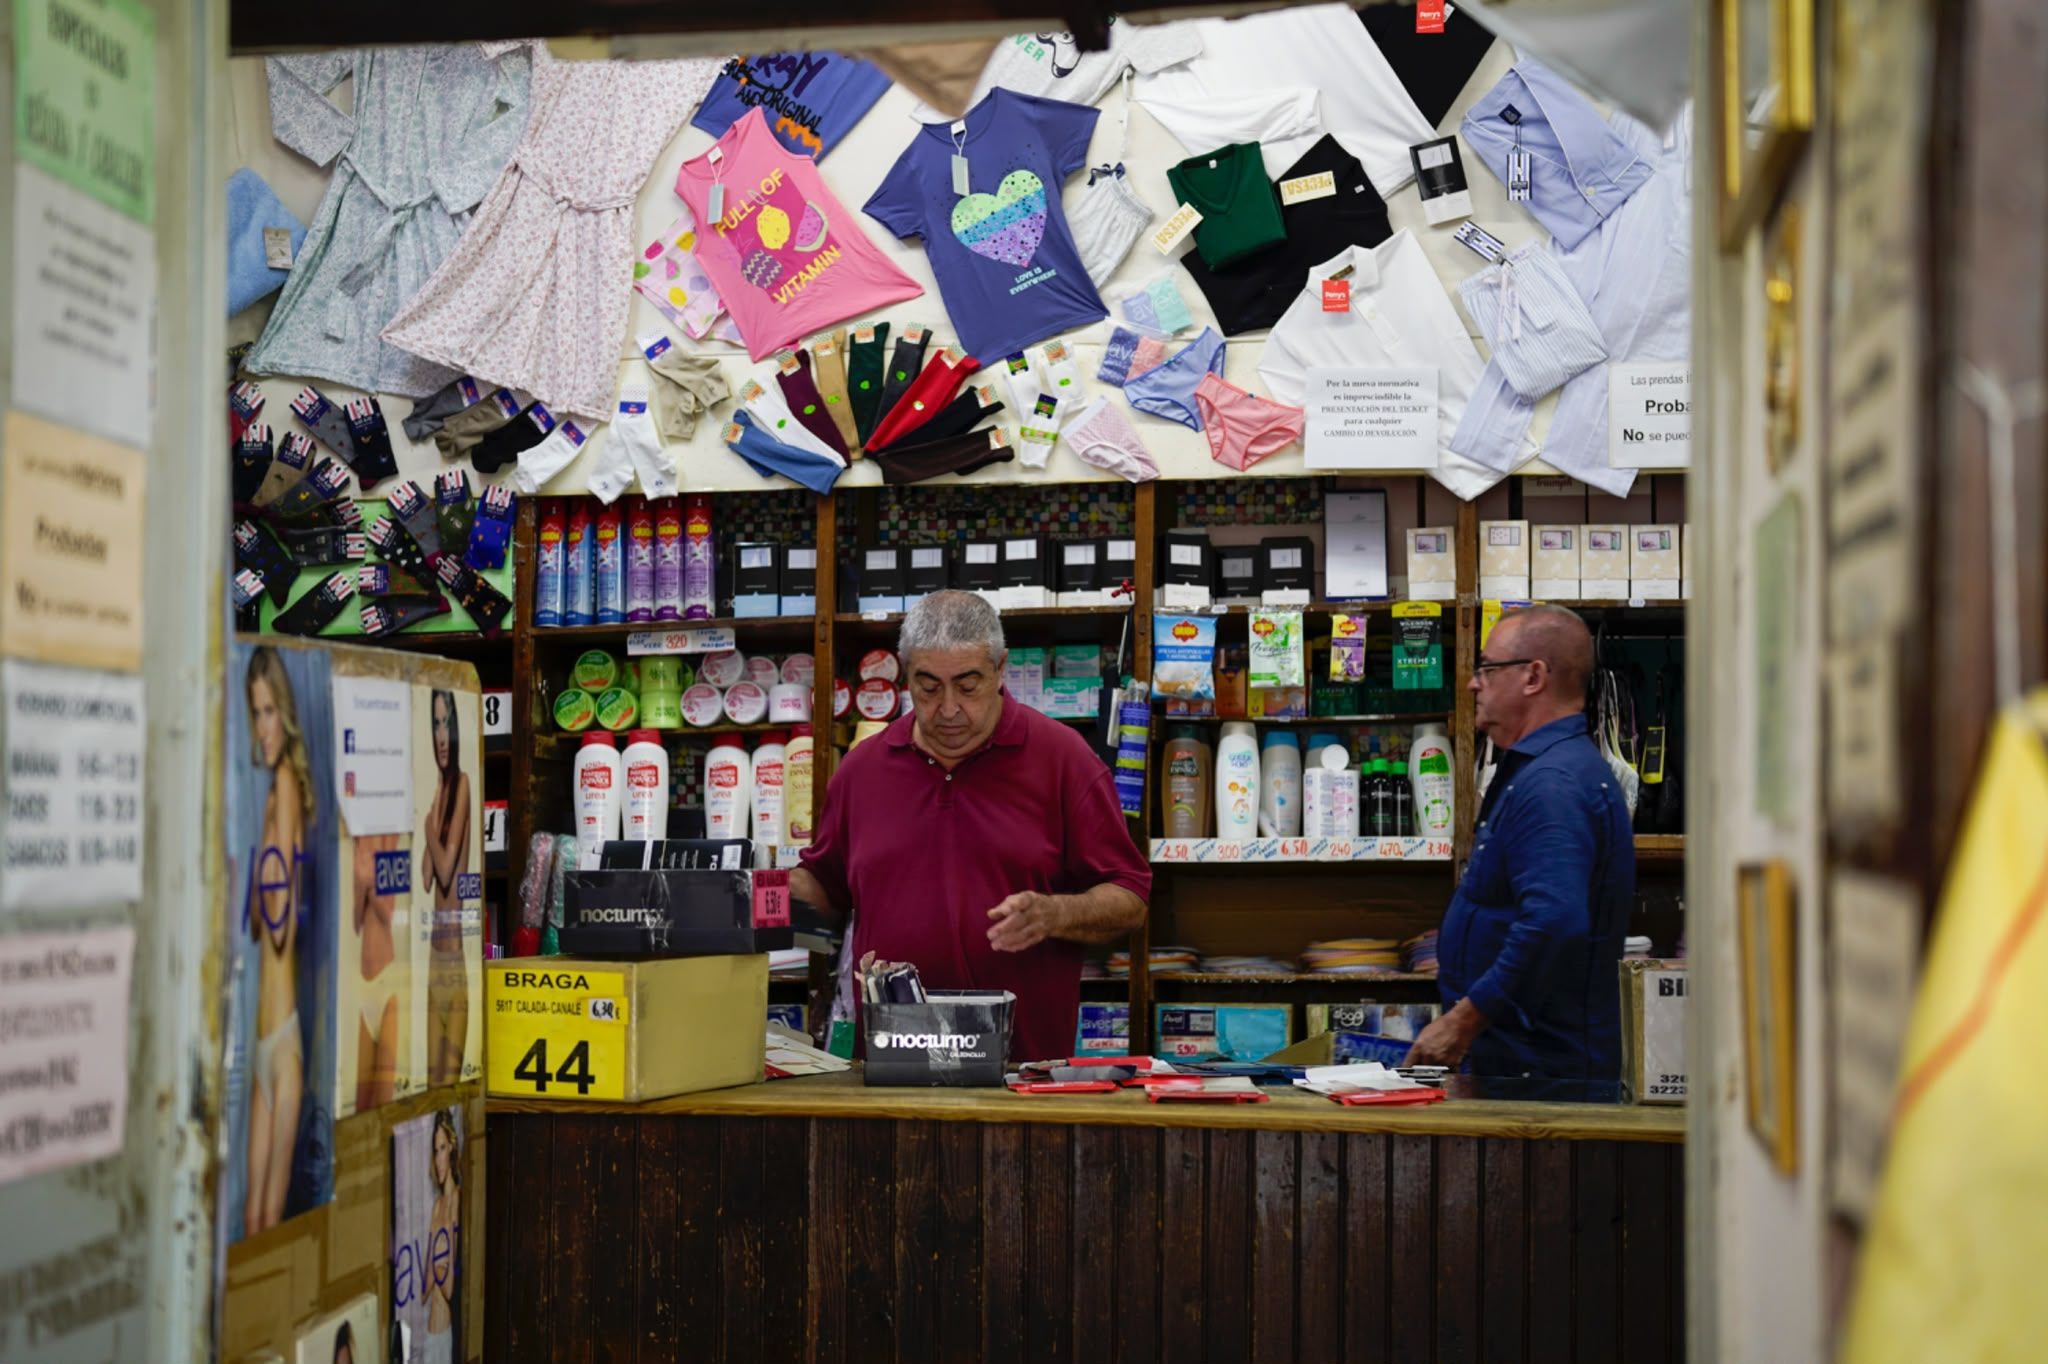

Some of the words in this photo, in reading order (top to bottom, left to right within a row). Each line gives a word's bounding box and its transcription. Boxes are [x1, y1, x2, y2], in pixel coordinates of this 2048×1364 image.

[714, 198, 757, 239] FULL
[759, 167, 784, 196] OF
[772, 244, 843, 305] VITAMIN
[1014, 270, 1034, 284] LOVE
[1033, 266, 1043, 275] IS
[1009, 269, 1057, 296] EVERYWHERE
[1326, 379, 1340, 388] Por
[1342, 379, 1351, 388] la
[1377, 379, 1420, 388] normativa
[1630, 375, 1647, 386] Las
[1648, 374, 1684, 387] prendas
[1333, 393, 1342, 401] es
[1343, 392, 1402, 402] imprescindible
[1403, 392, 1412, 401] la
[1382, 405, 1398, 414] DEL
[1399, 405, 1429, 414] TICKET
[1344, 418, 1363, 427] para
[1364, 417, 1403, 427] cualquier
[1323, 429, 1356, 438] CAMBIO
[1357, 430, 1364, 438] O
[1623, 428, 1645, 441] No
[1648, 432, 1662, 441] se
[1430, 656, 1437, 665] 3
[485, 695, 501, 727] 8
[504, 971, 590, 991] BRAGA
[891, 1033, 977, 1049] nocturno
[514, 1037, 596, 1095] 44
